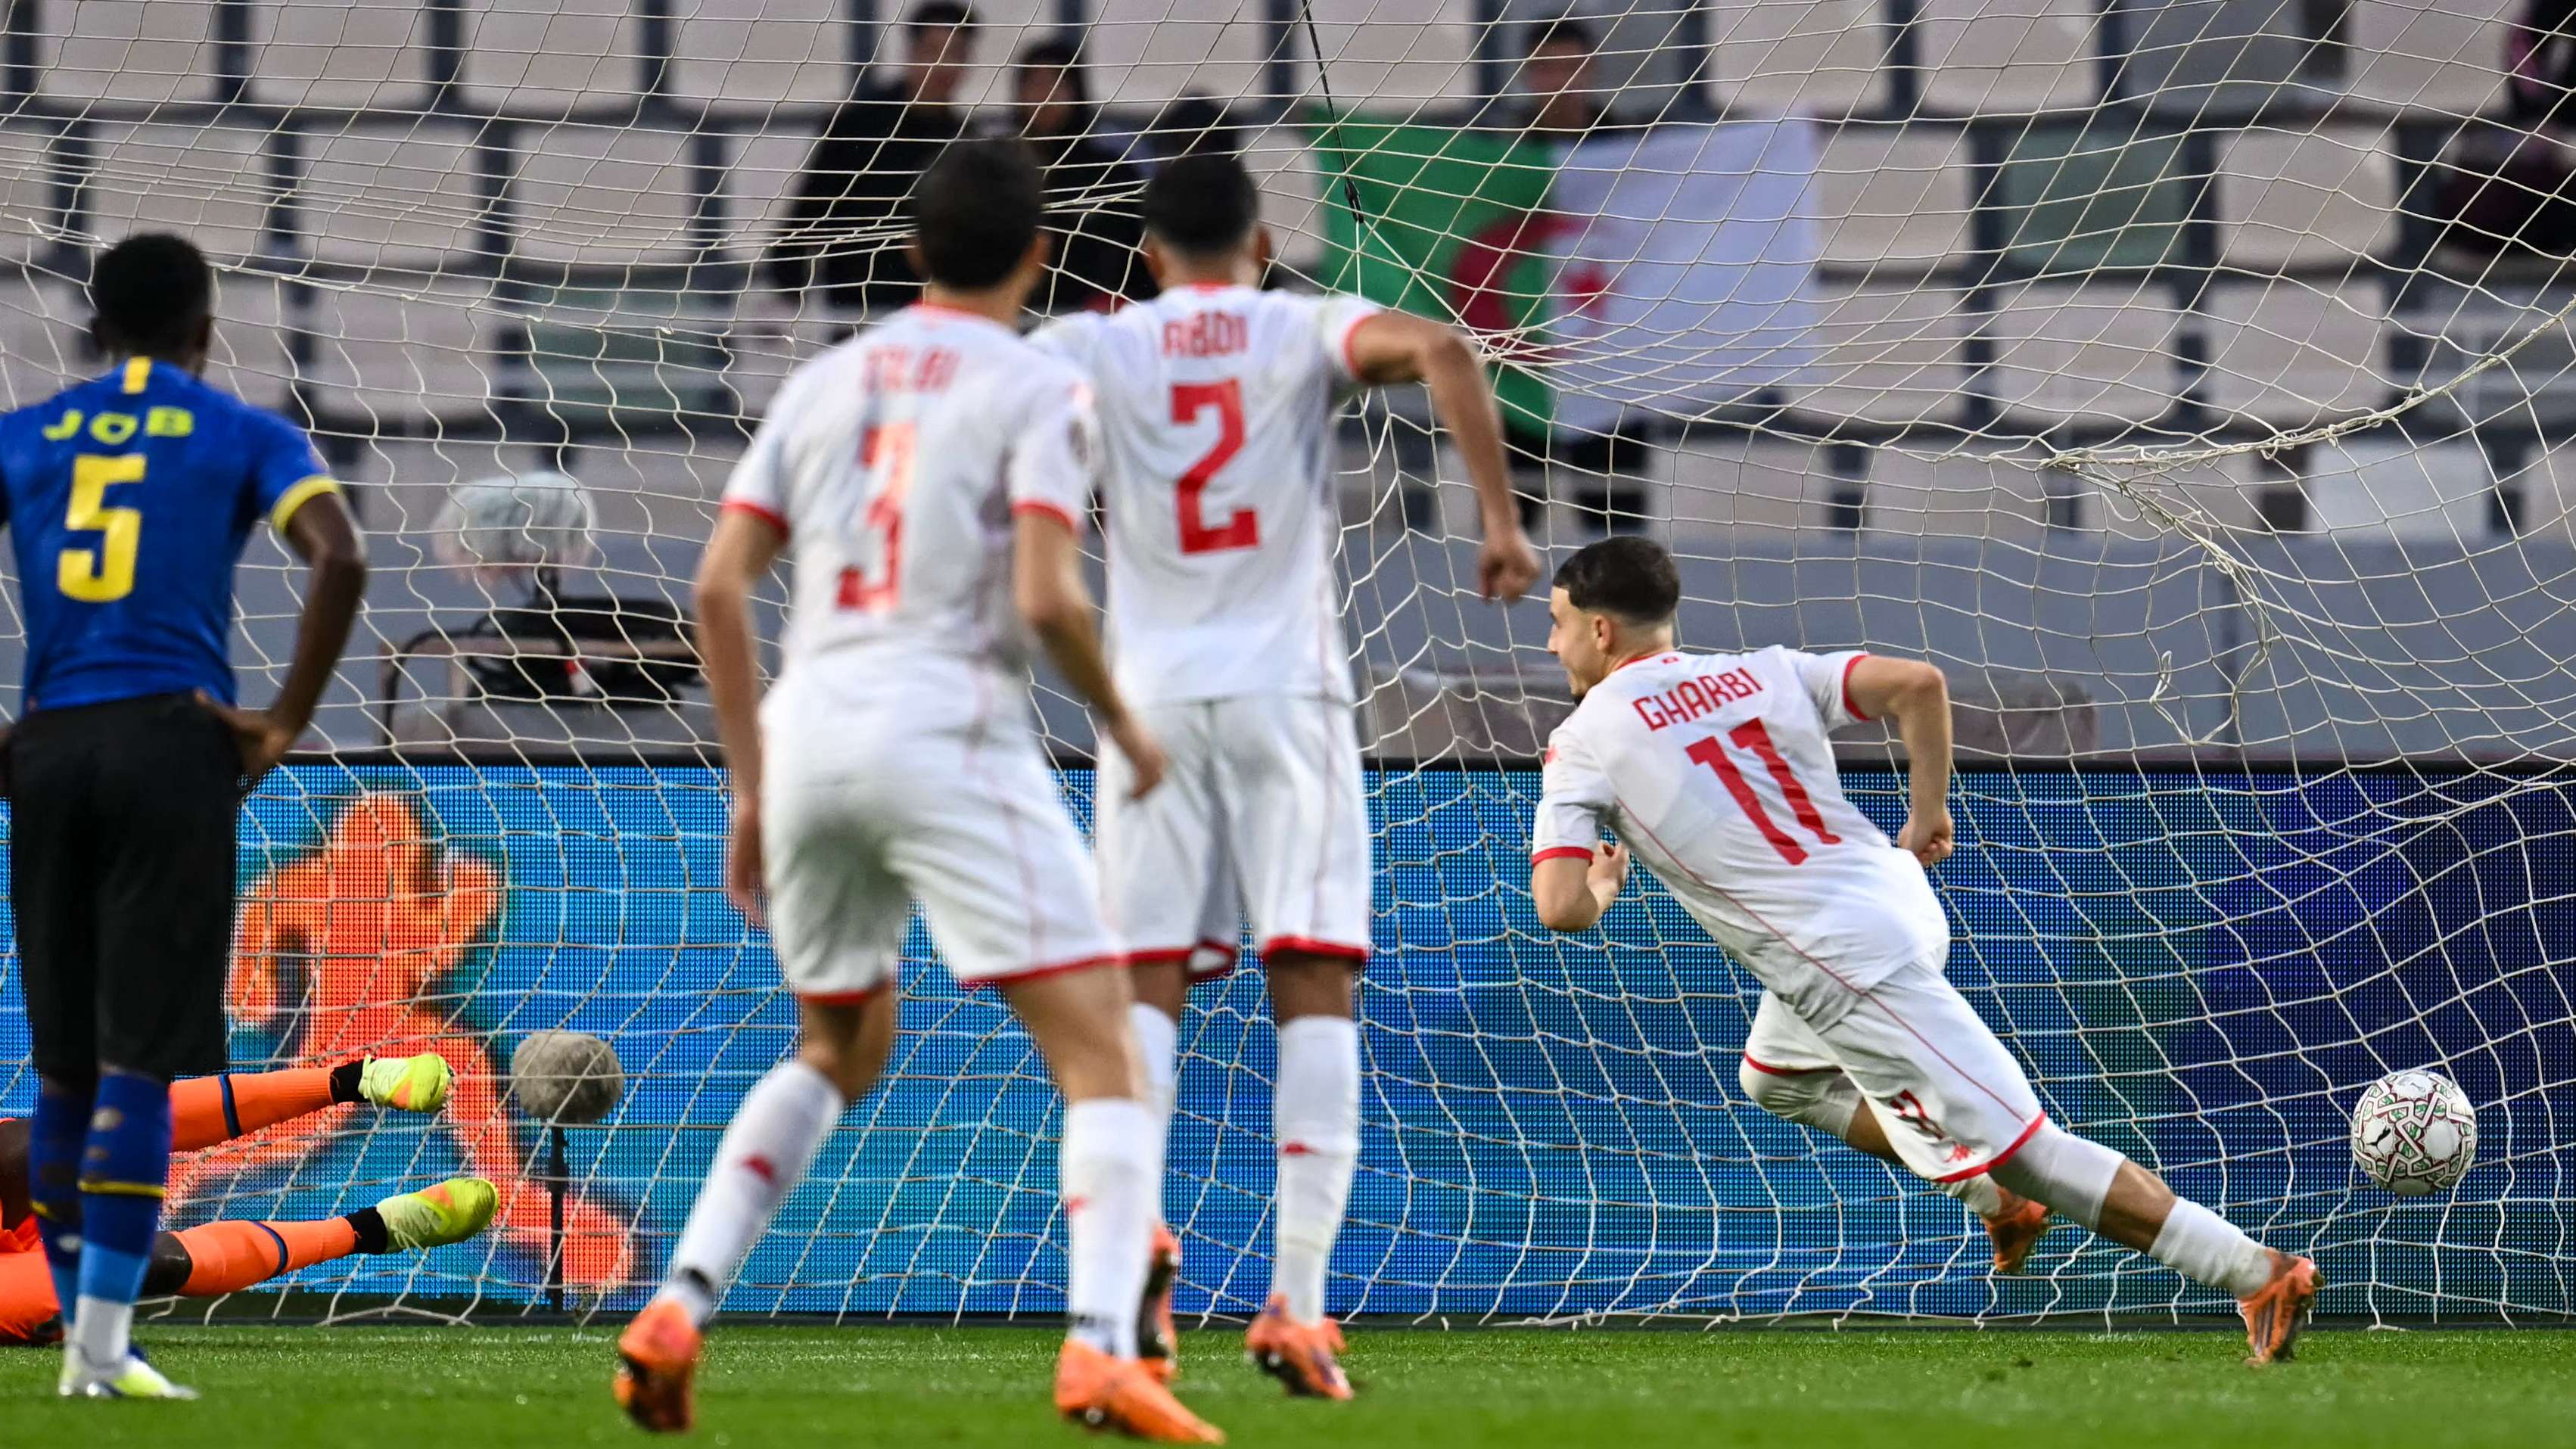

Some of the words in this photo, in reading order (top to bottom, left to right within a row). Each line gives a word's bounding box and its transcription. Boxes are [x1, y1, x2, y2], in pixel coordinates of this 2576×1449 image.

[42, 407, 194, 445] JOB
[1171, 378, 1259, 555] 2
[58, 454, 147, 602] 5
[835, 421, 917, 611] 3
[1632, 667, 1764, 732] GHARBI
[1685, 717, 1842, 866] 11
